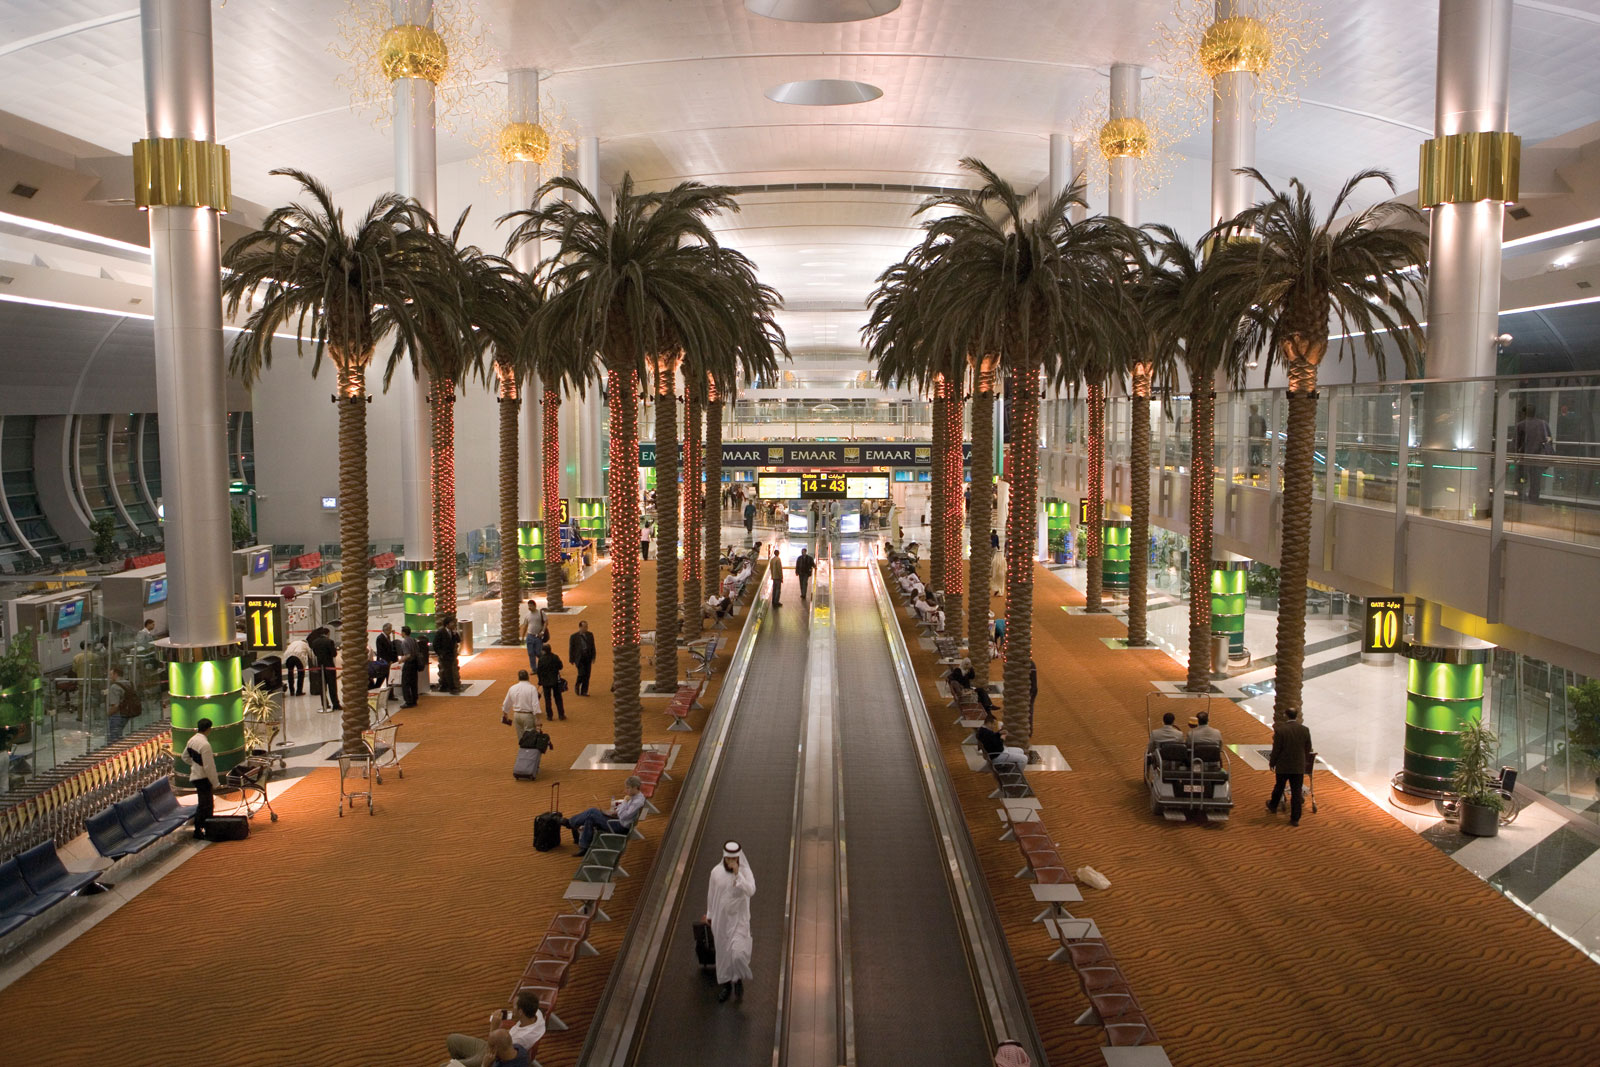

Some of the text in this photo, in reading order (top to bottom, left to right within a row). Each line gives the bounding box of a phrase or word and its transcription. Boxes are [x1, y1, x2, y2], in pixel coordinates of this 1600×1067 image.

[791, 451, 837, 460] EMAAR
[866, 451, 912, 460] EMAAR
[802, 480, 818, 492] 14
[829, 480, 845, 492] 43
[251, 610, 277, 646] 11
[1371, 611, 1398, 648] 10
